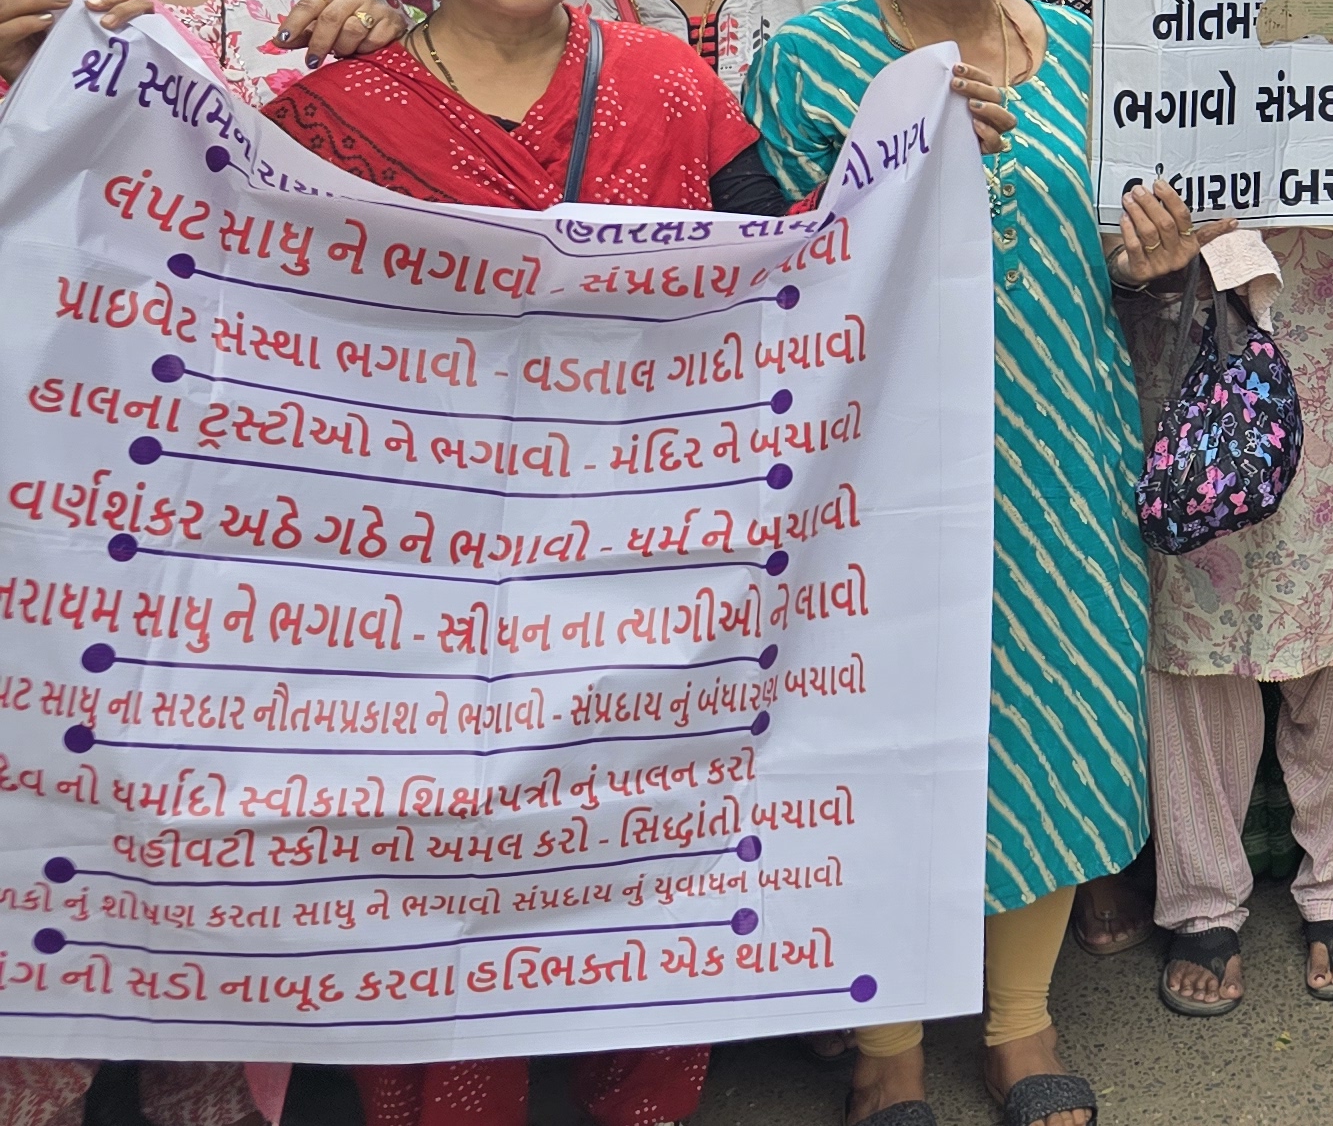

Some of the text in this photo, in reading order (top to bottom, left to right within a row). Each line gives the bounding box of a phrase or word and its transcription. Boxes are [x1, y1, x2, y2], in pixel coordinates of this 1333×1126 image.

[72, 37, 129, 97] શ્રી
[1113, 70, 1236, 130] ભગાવો
[878, 117, 929, 172] માગ
[105, 169, 740, 300] લંપટ સાધુ ને ભગાવો સંપ્રદાય
[55, 276, 866, 395] પ્રાઇવેટ સંસ્થા ભગાવો વડતાલ ગાદી બચાવો
[9, 470, 861, 569] વર્ણશંકર અઠે ગઠે ને ભગાવો ધર્મ ને બચાવો
[113, 828, 255, 868] વહીવટી
[268, 826, 360, 866] સ્કીમ
[371, 826, 415, 864] નો
[426, 831, 523, 864] અમલ
[533, 816, 589, 858] કરો
[751, 786, 855, 831] બચાવો
